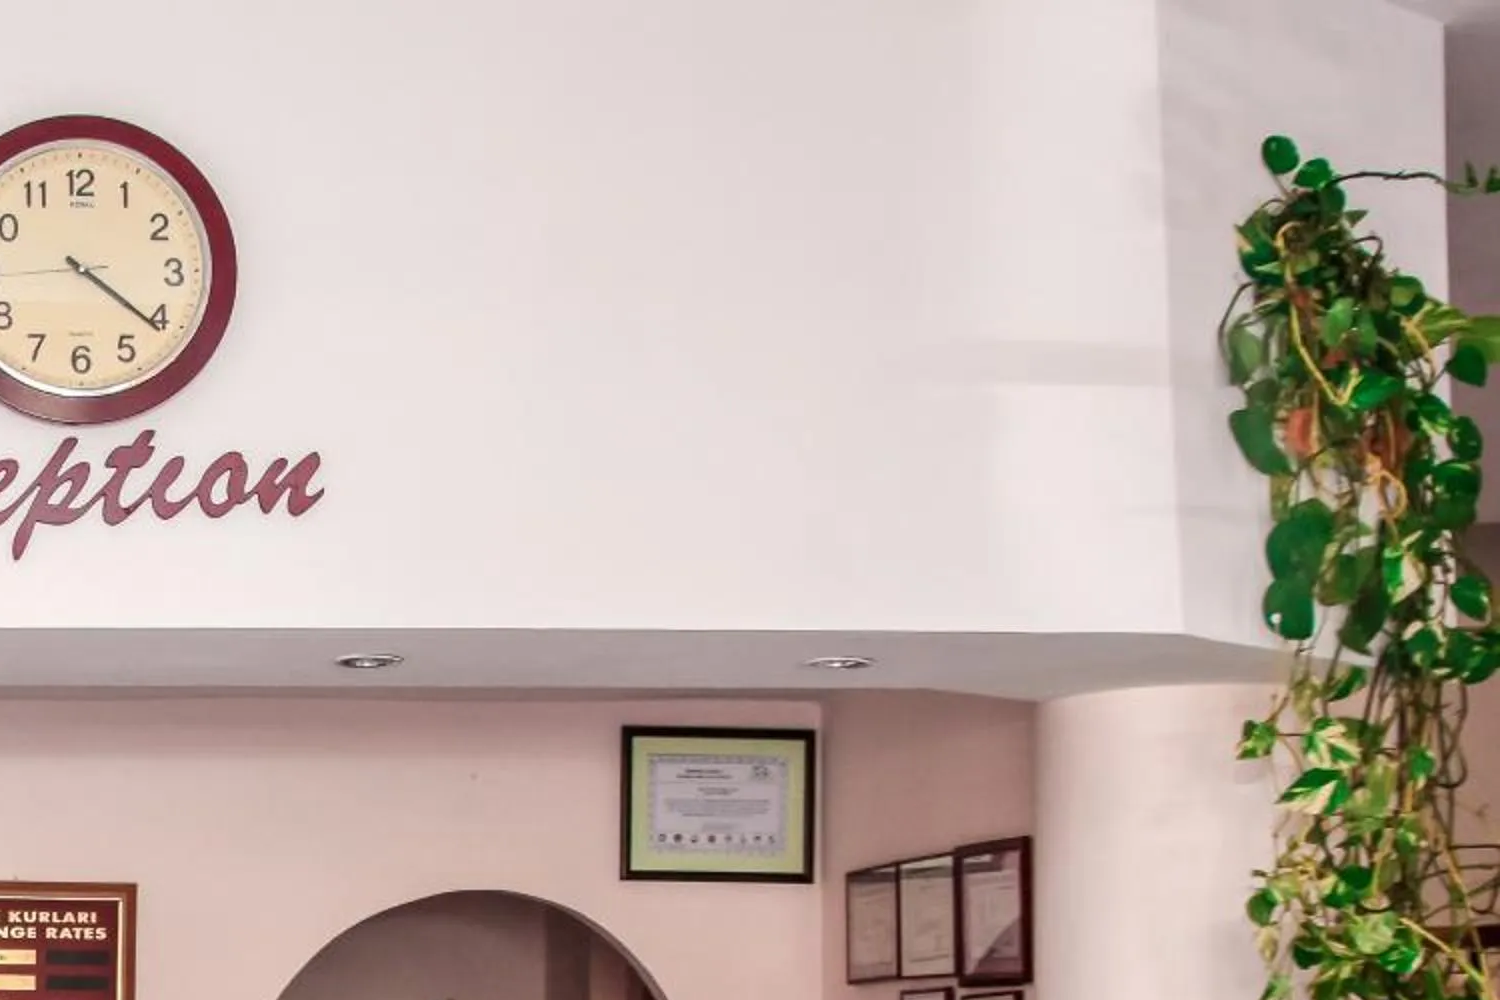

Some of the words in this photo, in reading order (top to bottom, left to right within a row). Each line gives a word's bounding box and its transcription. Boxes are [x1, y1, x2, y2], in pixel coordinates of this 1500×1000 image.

[23, 181, 47, 208] 11
[65, 169, 95, 197] 12
[119, 181, 129, 208] 1
[149, 213, 169, 241] 2
[163, 257, 185, 287] 3
[149, 303, 170, 331] 4
[27, 333, 47, 362] 7
[70, 345, 92, 374] 6
[117, 334, 136, 363] 5
[45, 927, 107, 940] RATES
